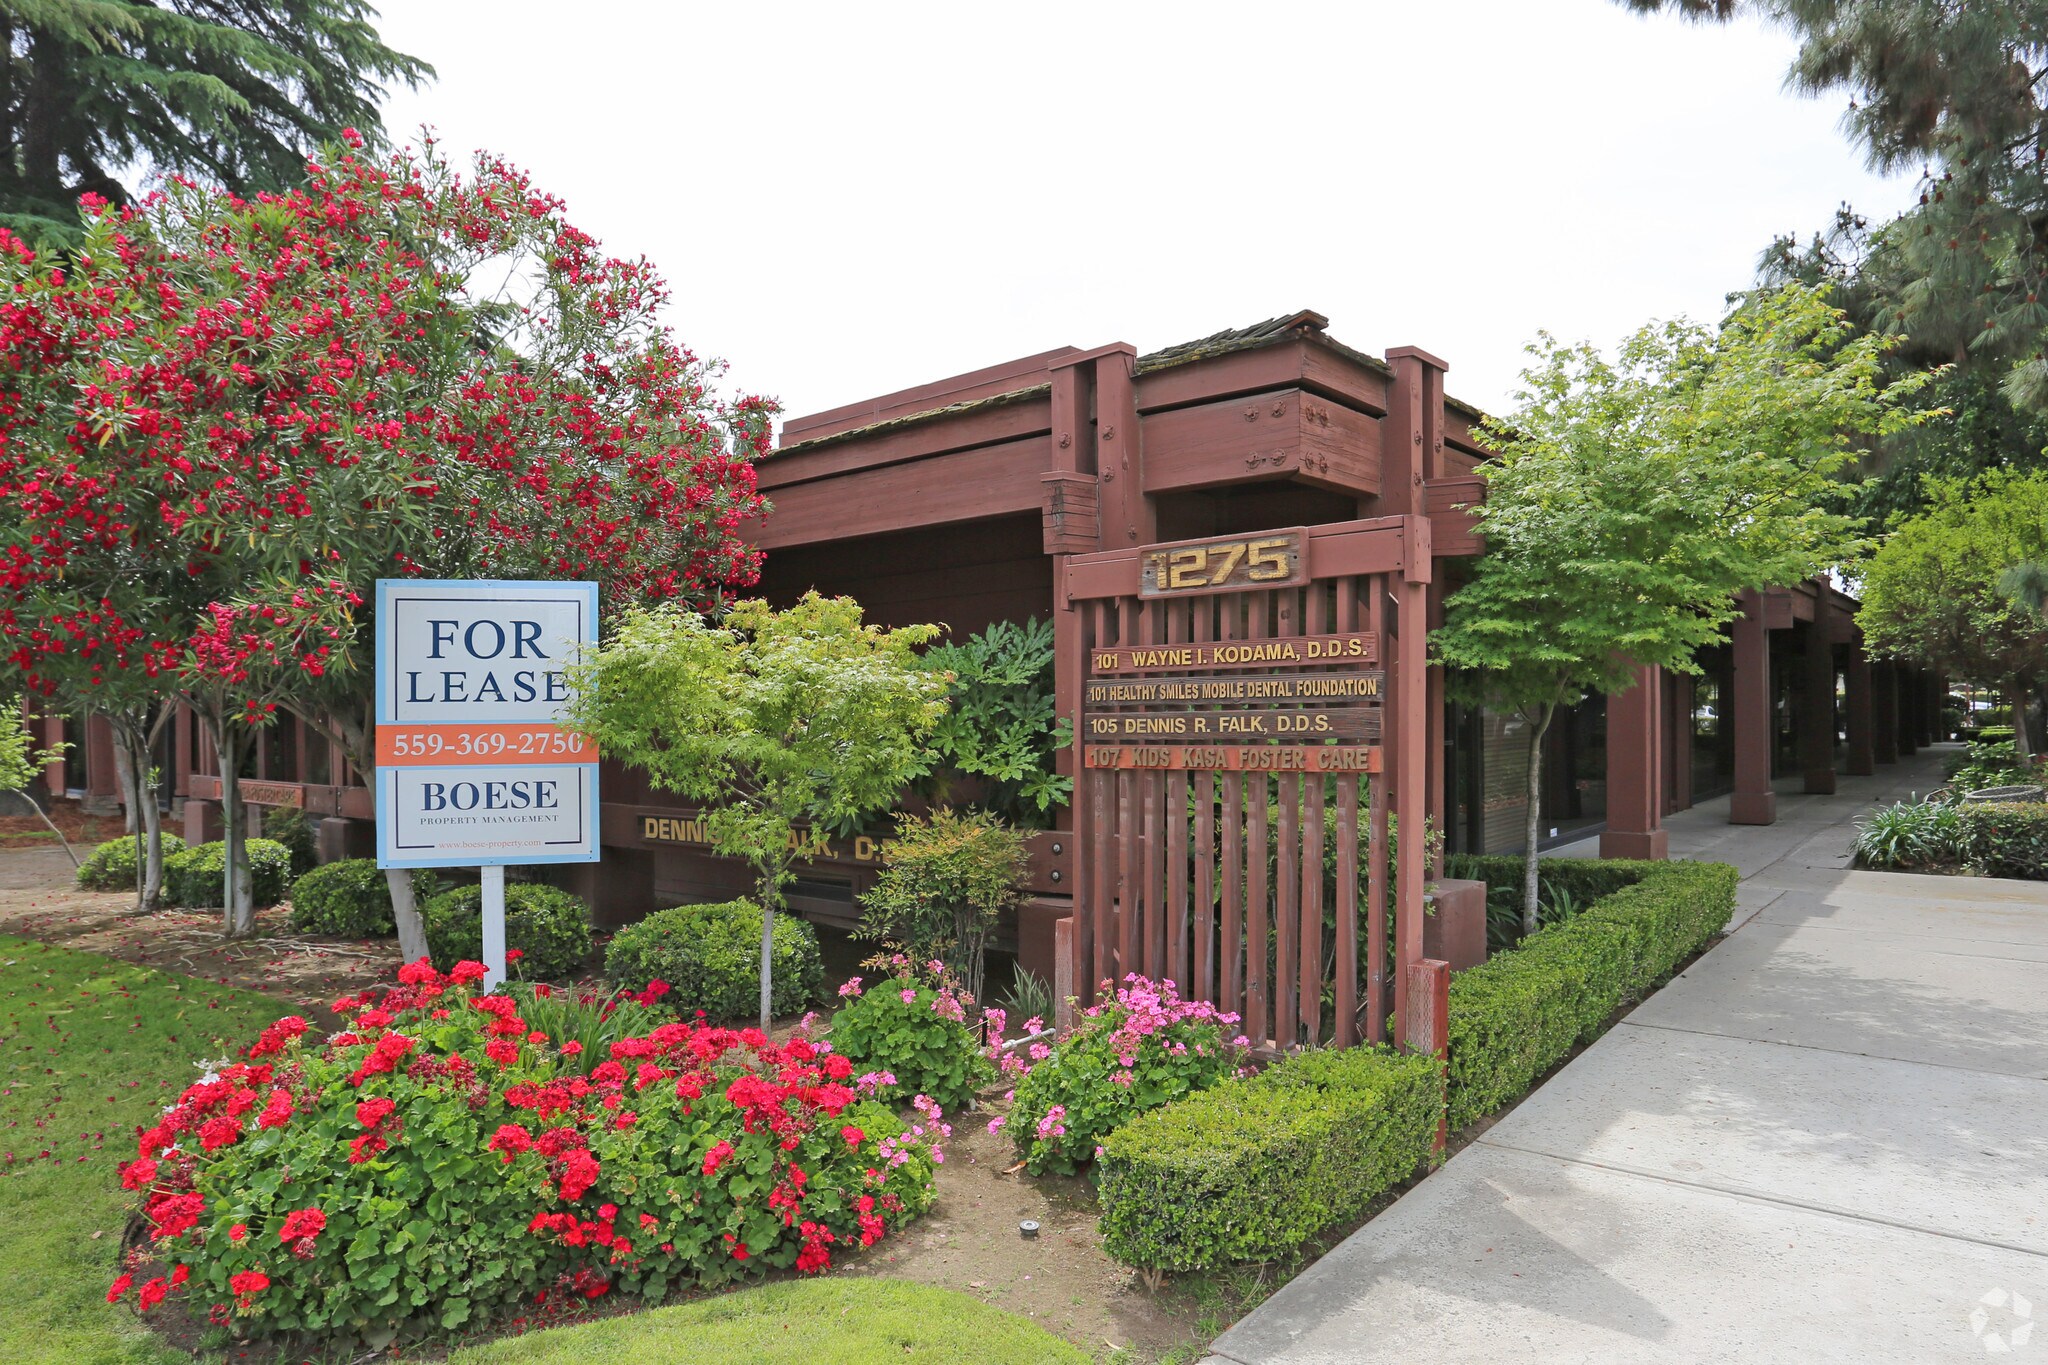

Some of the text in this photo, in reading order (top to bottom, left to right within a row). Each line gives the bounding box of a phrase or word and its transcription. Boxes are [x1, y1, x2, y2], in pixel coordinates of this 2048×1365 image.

[1150, 539, 1289, 590] 1275
[426, 619, 550, 660] FOR
[1096, 653, 1118, 669] 101
[1131, 649, 1192, 667] WAYNE
[1213, 642, 1301, 664] KODAMA,
[1307, 638, 1368, 659] D.D.S.
[405, 670, 571, 703] LEASE
[1089, 678, 1377, 701] 101 HEALTHY SMILES MOBILE DENTAL FOUNDATION
[1090, 714, 1333, 735] 105 DENNIS R. FALK, D.D.S.
[393, 732, 583, 756] 559-369-2750
[1090, 747, 1368, 770] 107 KIDS KASA FOSTER CARE
[420, 781, 558, 811] BOESE
[420, 814, 560, 825] PROPERTY MANAGEMENT
[438, 840, 542, 849] www.boese-property.com
[786, 829, 839, 860] ALK,
